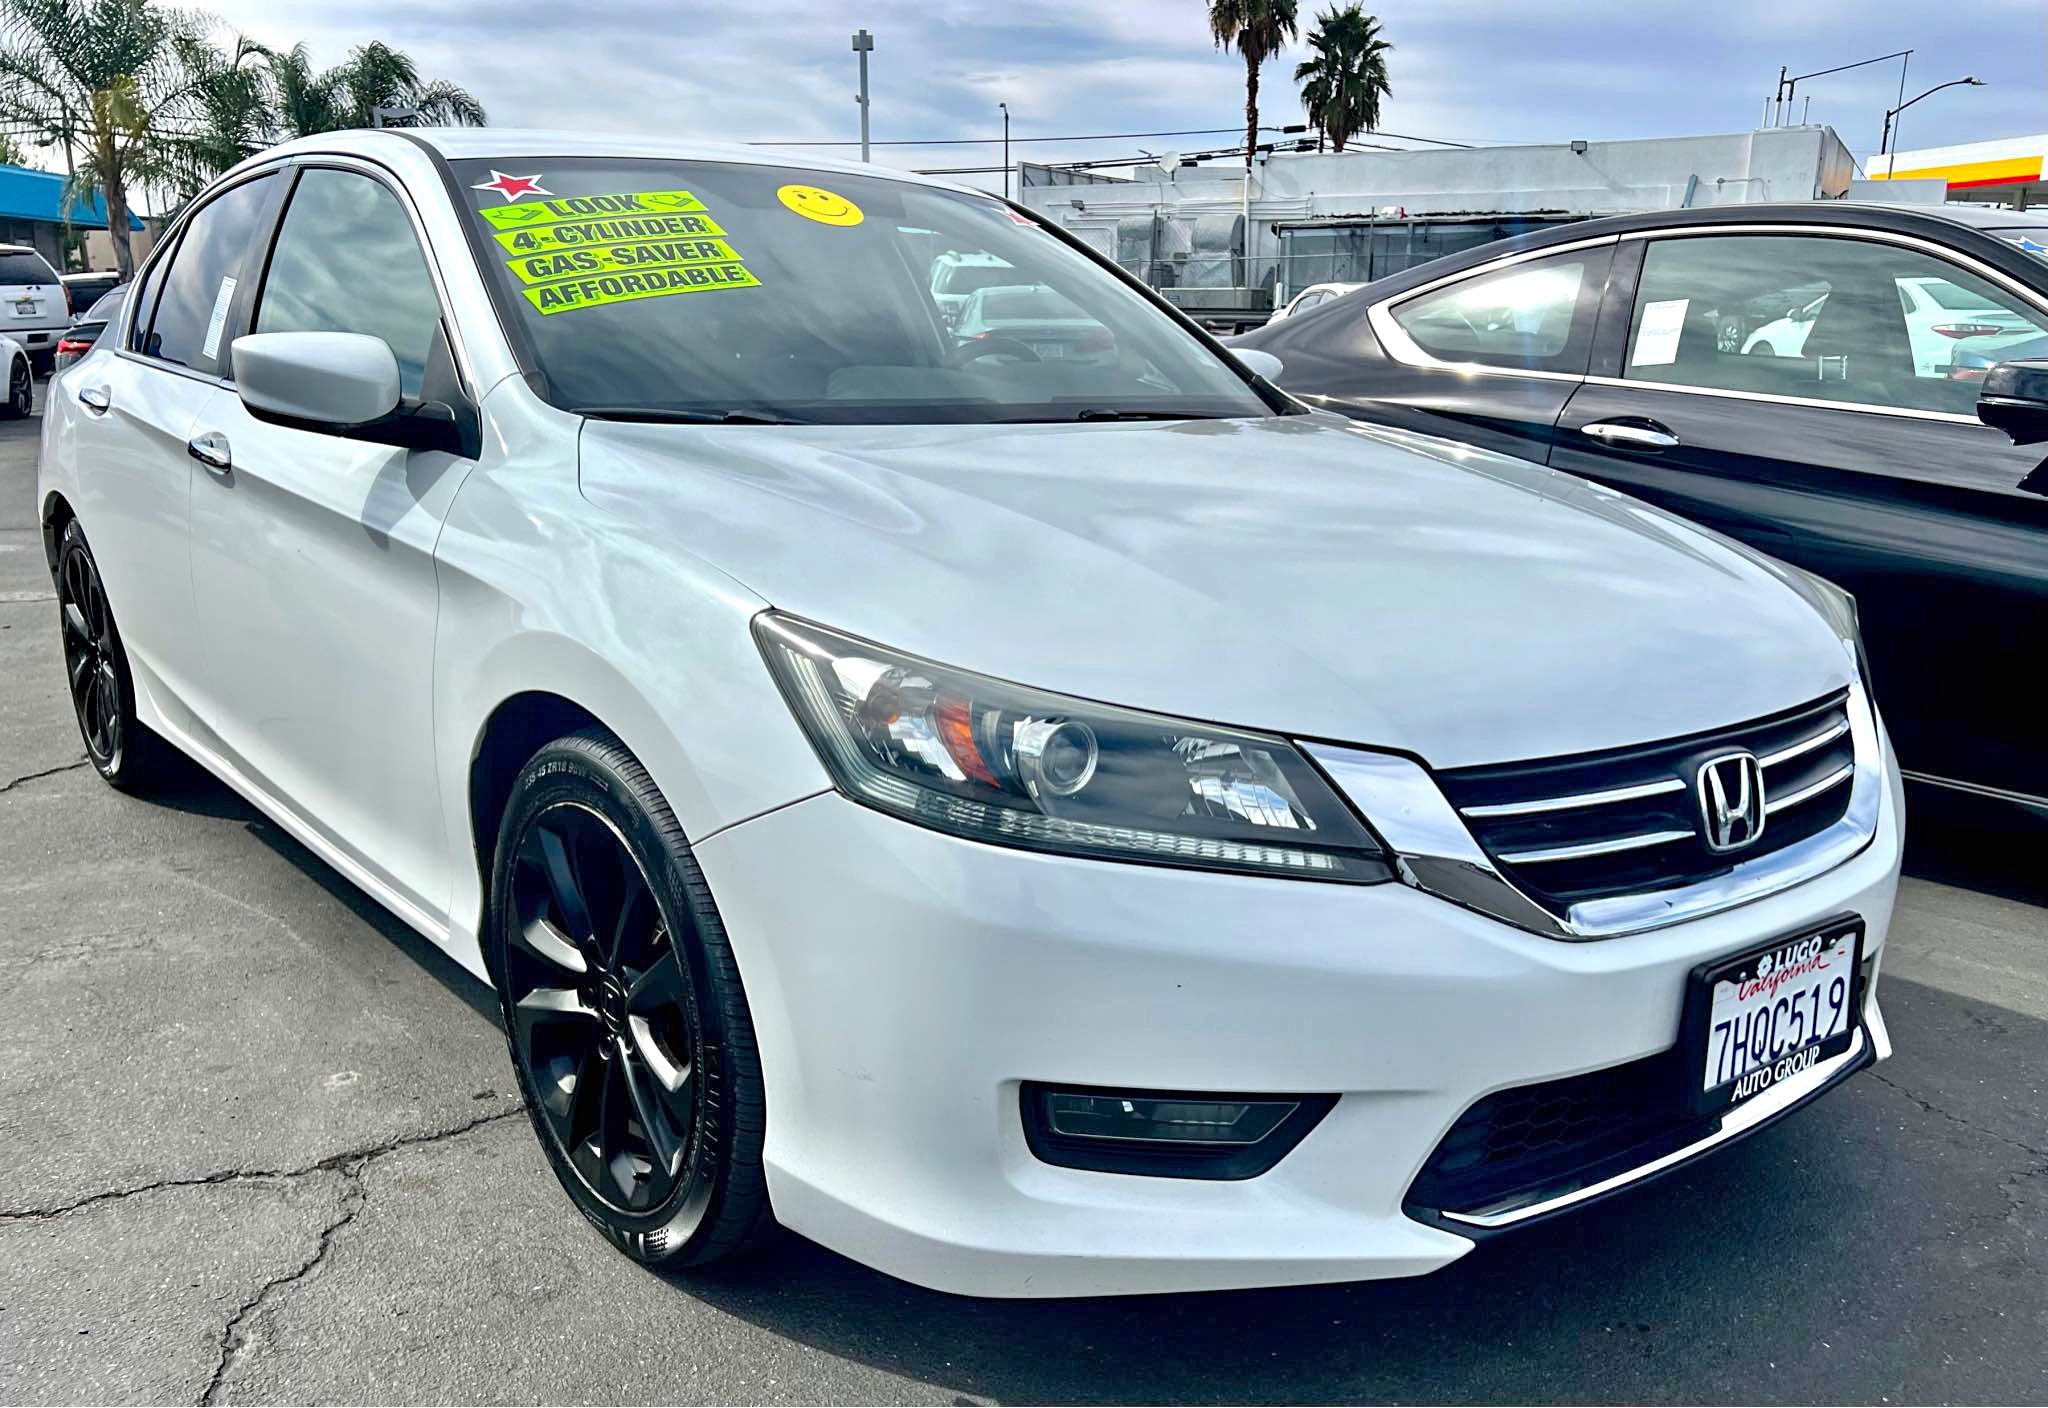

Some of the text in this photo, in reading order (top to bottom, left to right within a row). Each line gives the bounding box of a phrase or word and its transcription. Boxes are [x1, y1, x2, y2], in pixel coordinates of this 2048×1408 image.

[543, 194, 646, 217] LOOK
[512, 216, 708, 250] 4-CYLINDER
[525, 242, 722, 278] GAS-SAVER
[539, 265, 745, 309] AFFORDABLE
[1775, 936, 1823, 971] LUGO
[1739, 954, 1831, 1001] California
[1714, 976, 1845, 1085] 7HQC519
[1731, 1045, 1820, 1101] AUTO GROUP
